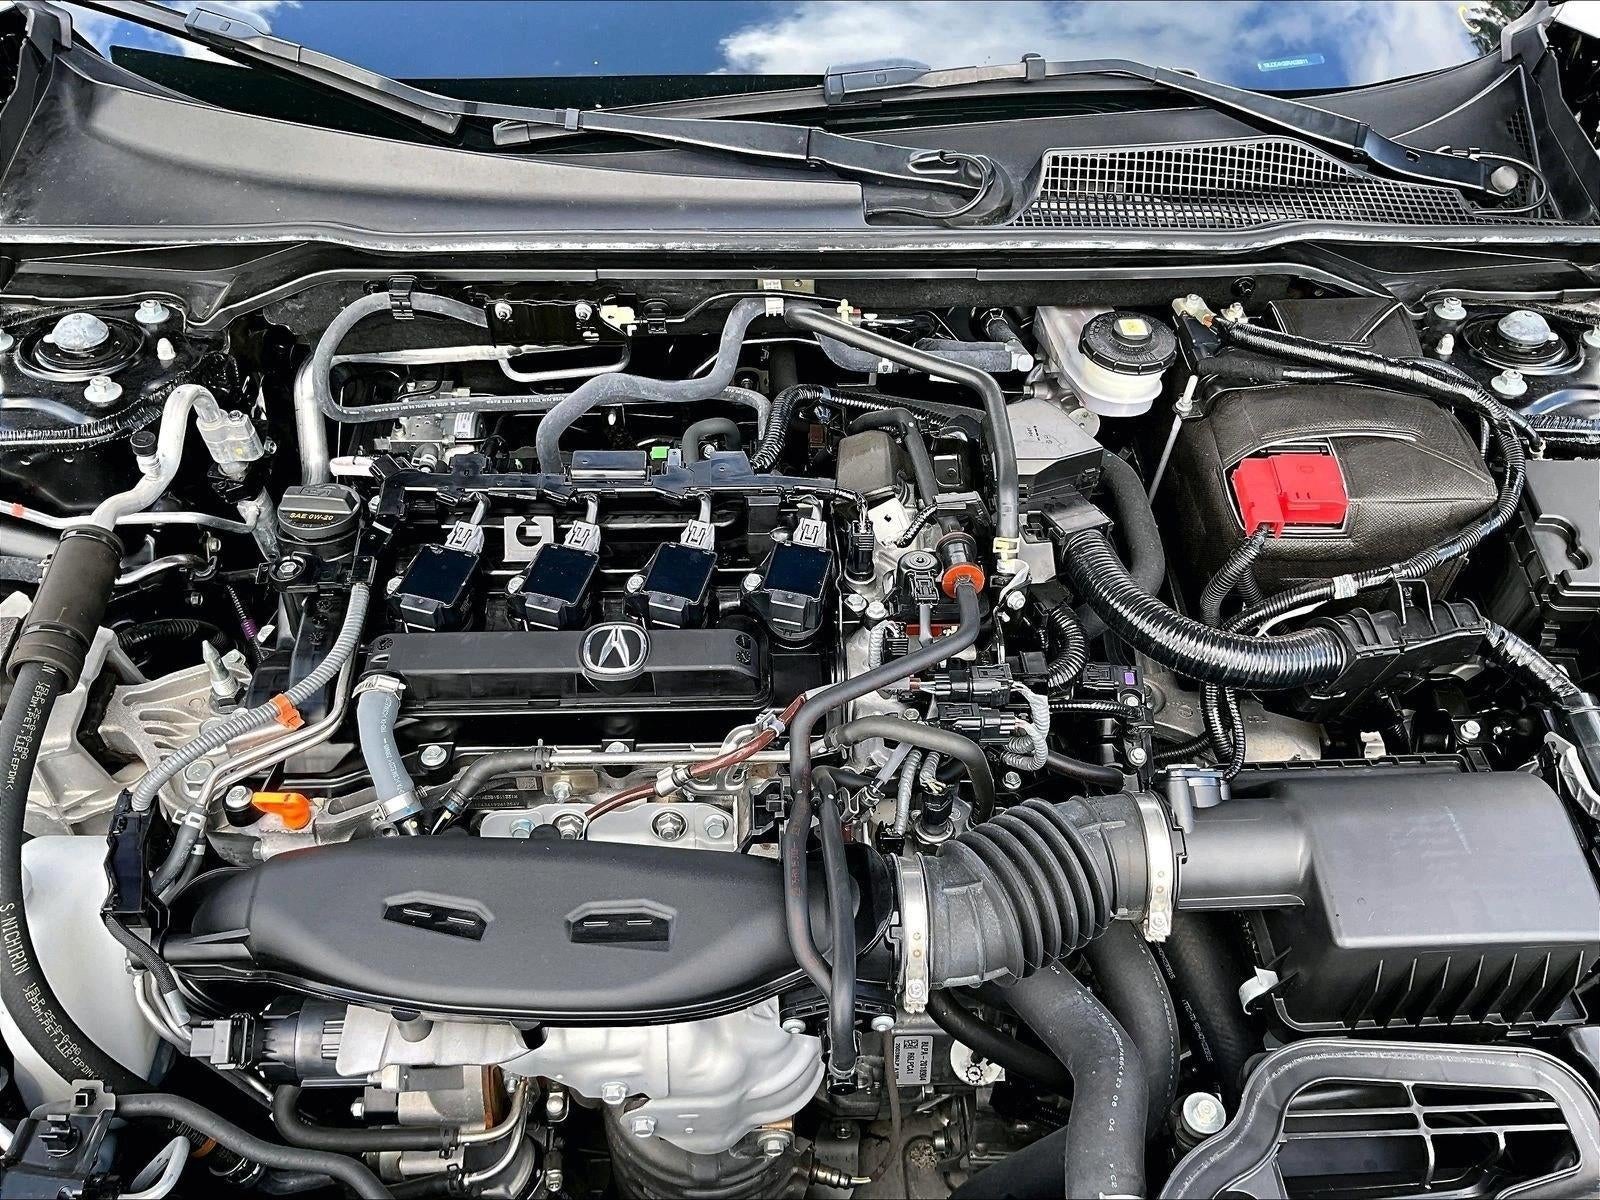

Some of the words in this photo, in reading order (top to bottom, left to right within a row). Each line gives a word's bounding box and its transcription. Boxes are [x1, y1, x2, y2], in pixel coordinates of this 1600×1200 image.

[290, 512, 307, 520] SAE
[308, 513, 334, 521] 0W-20
[40, 682, 51, 705] 15LP
[1050, 965, 1061, 975] 04
[1108, 1118, 1115, 1132] 04
[1110, 1174, 1118, 1189] C2
